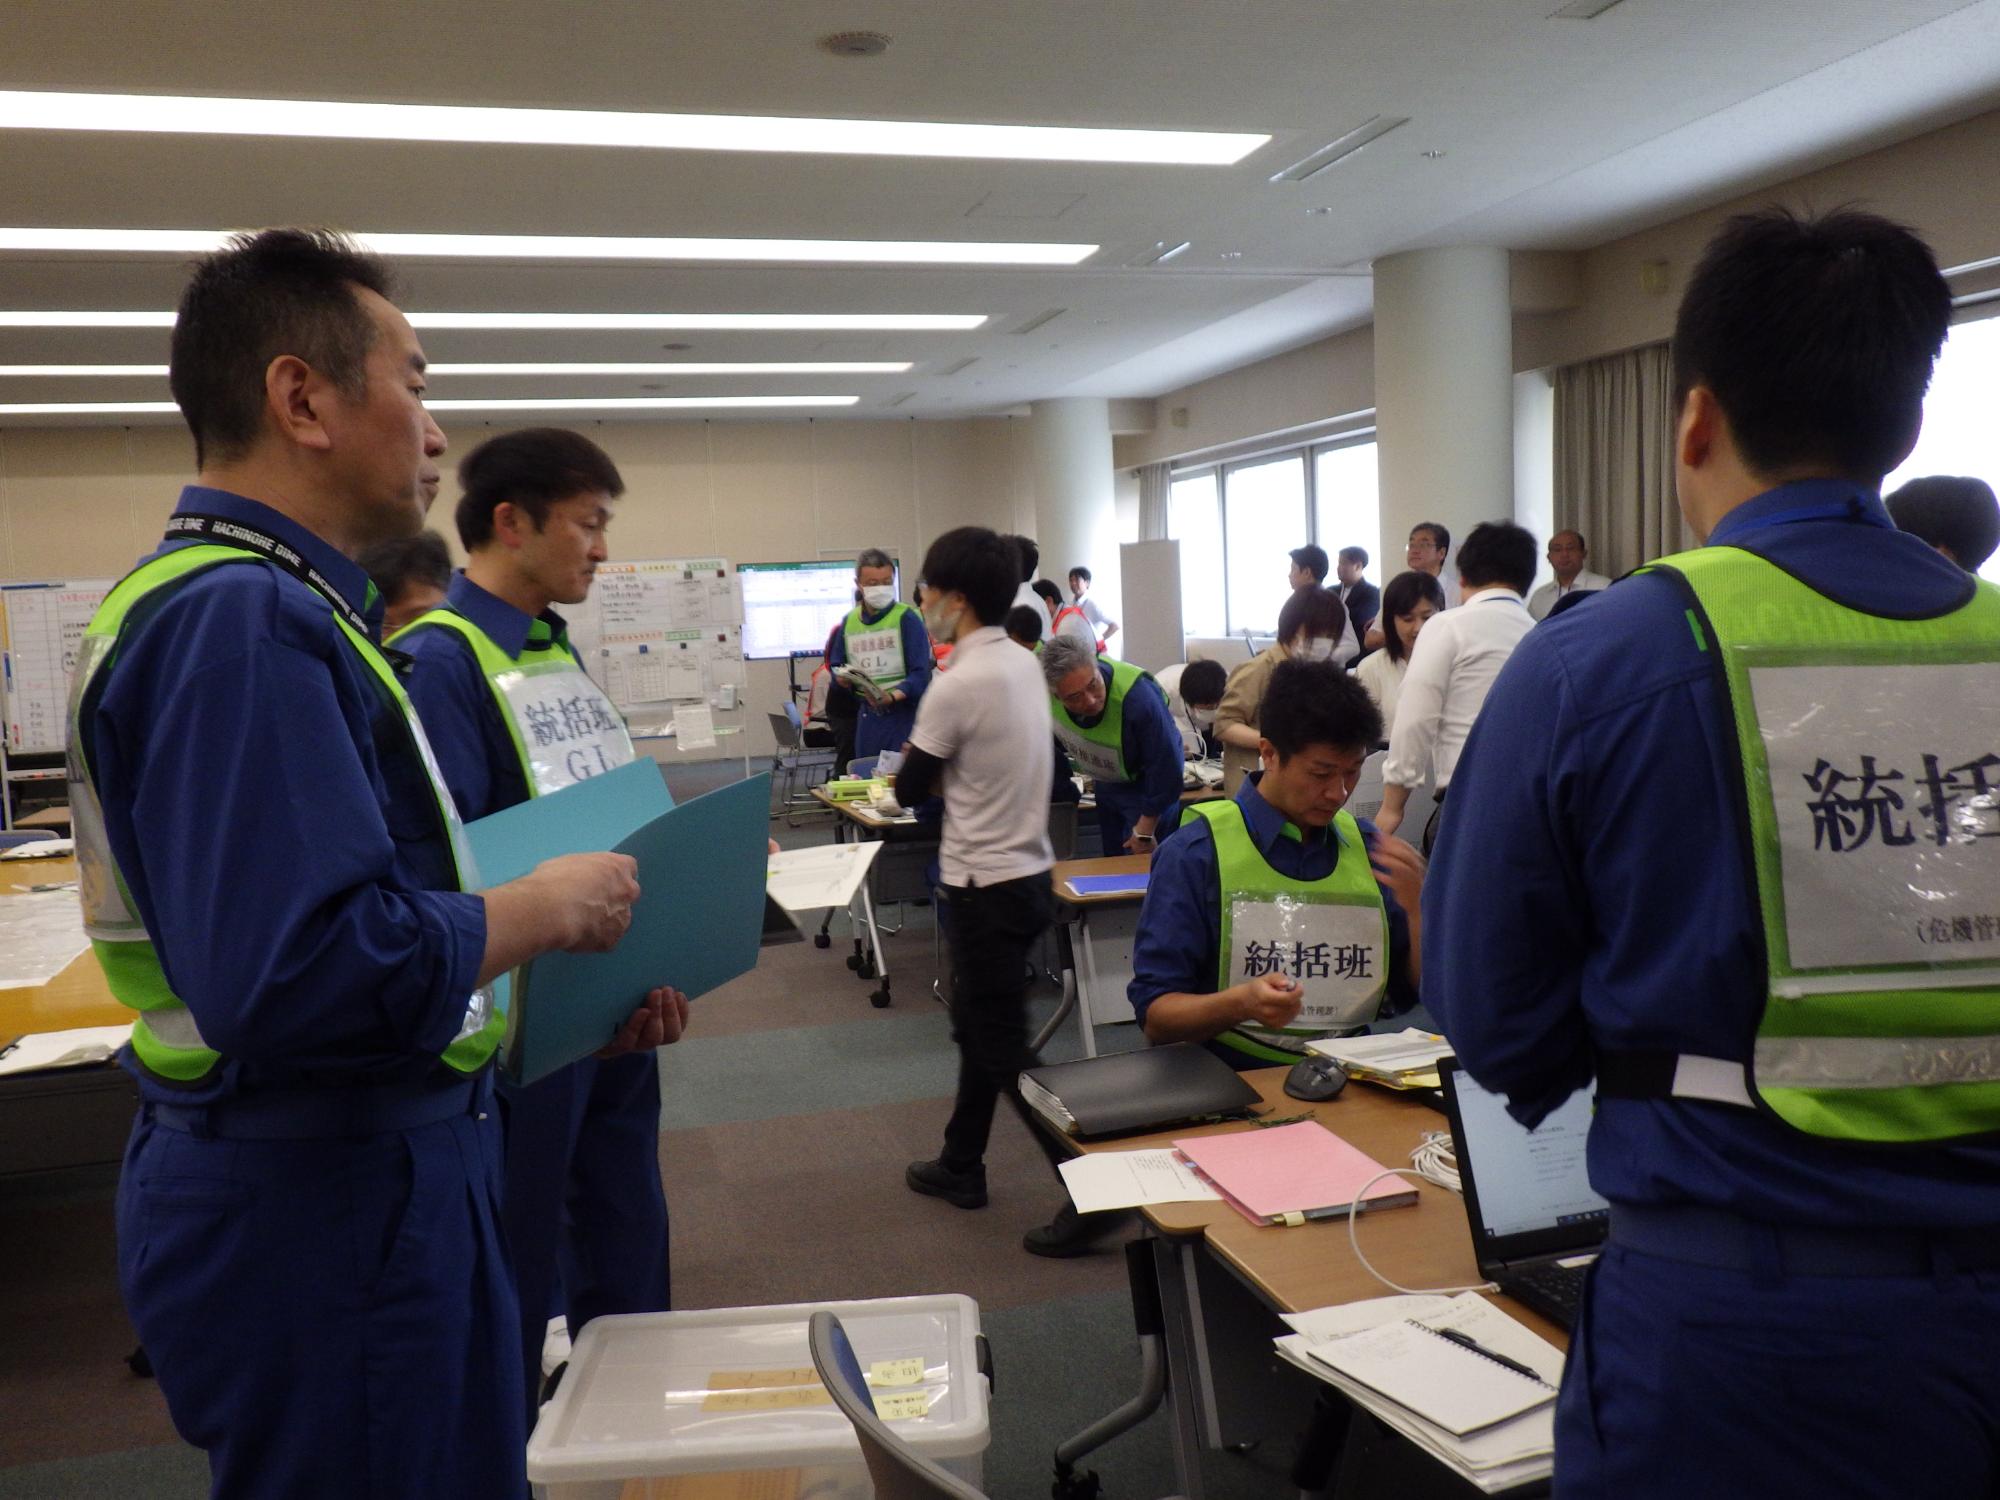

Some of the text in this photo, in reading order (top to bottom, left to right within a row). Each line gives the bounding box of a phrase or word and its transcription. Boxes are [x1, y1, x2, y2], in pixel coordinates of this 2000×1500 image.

[212, 520, 276, 551] HACHINOHE
[524, 695, 617, 747] 統括班
[1802, 752, 2000, 852] 統括
[1243, 939, 1374, 981] 統括班
